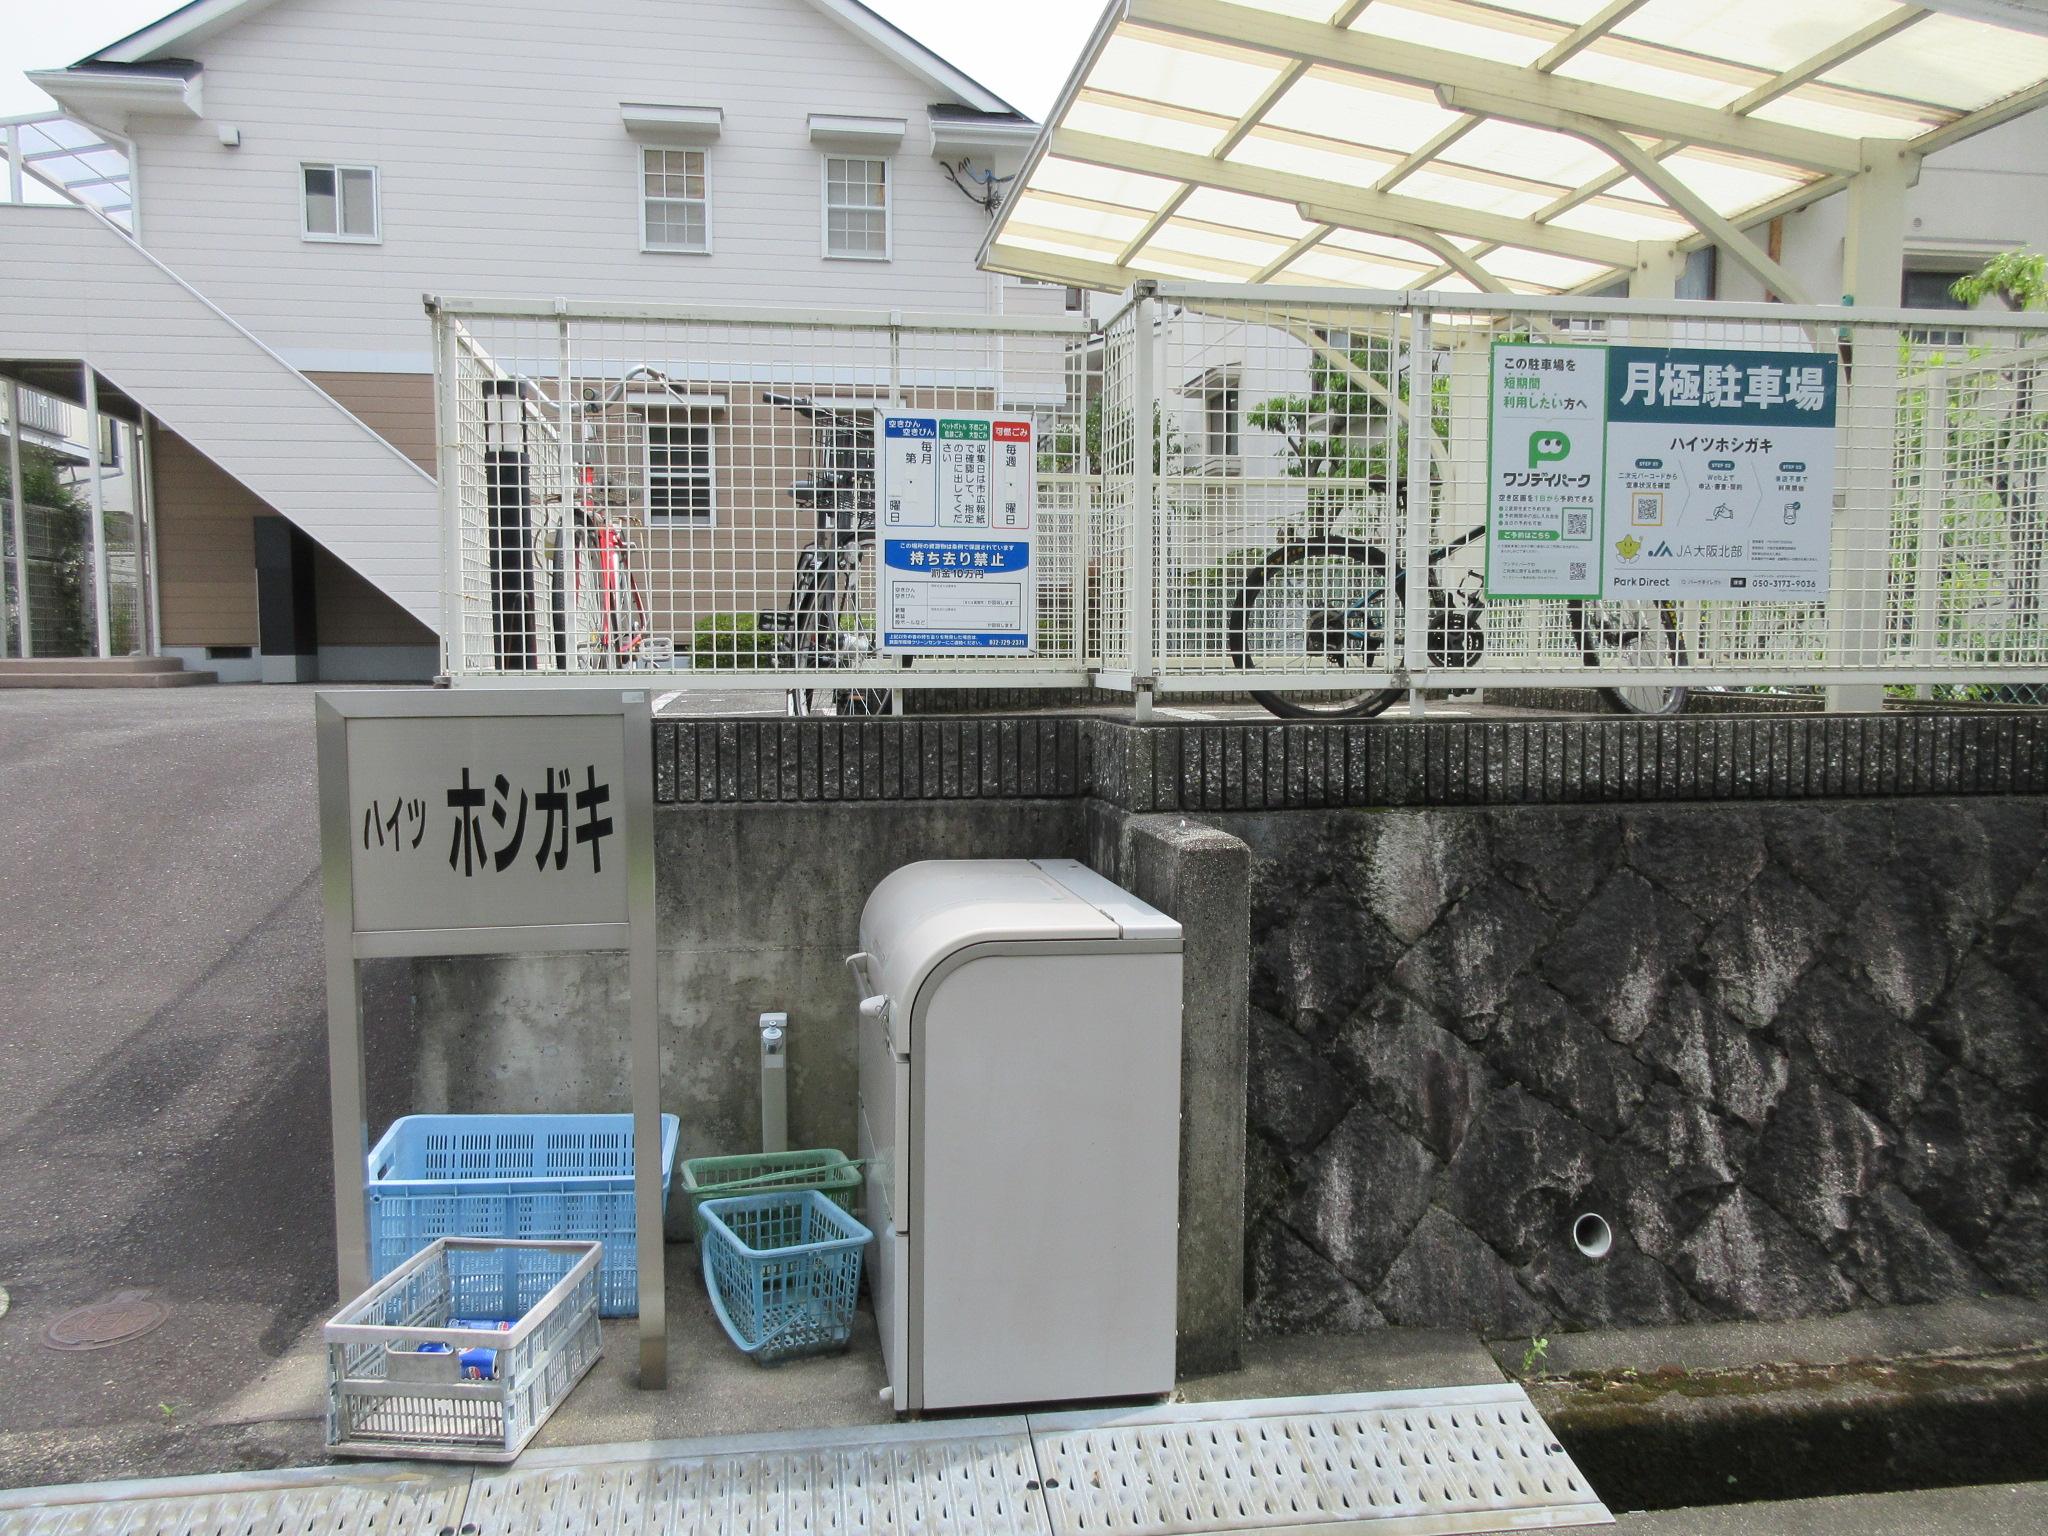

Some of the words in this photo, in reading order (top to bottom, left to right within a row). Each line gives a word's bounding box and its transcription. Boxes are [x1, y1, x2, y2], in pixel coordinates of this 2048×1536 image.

[1504, 358, 1576, 372] この駐車場を
[1504, 377, 1540, 390] 短期間
[1620, 362, 1825, 411] 月極駐車場
[1503, 396, 1588, 410] 利用したい方へ
[888, 420, 921, 428] 空きかん
[995, 427, 1028, 436] 可燃ごみ
[902, 428, 935, 437] 空きびん
[921, 441, 932, 464] 毎月
[942, 443, 952, 462] さい
[1670, 437, 1773, 454] ハイツホシガキ
[905, 453, 917, 464] 第
[1006, 444, 1016, 467] 毎週
[954, 444, 963, 524] の日に出してくだ
[965, 444, 974, 524] で確認して、指定
[976, 444, 986, 524] 収集日は市広報紙
[1498, 495, 1594, 503] 空き区画を1日から予約できる
[890, 500, 900, 522] 曜日
[1005, 503, 1016, 524] 曜日
[910, 551, 1005, 567] 持ち去り禁止
[1676, 545, 1743, 558] JA大阪北部
[931, 569, 984, 579] 罰金10万円
[1613, 577, 1637, 586] Park
[1639, 577, 1670, 587] Direct
[364, 796, 427, 852] ハイツ
[446, 764, 614, 877] ホシガキ
